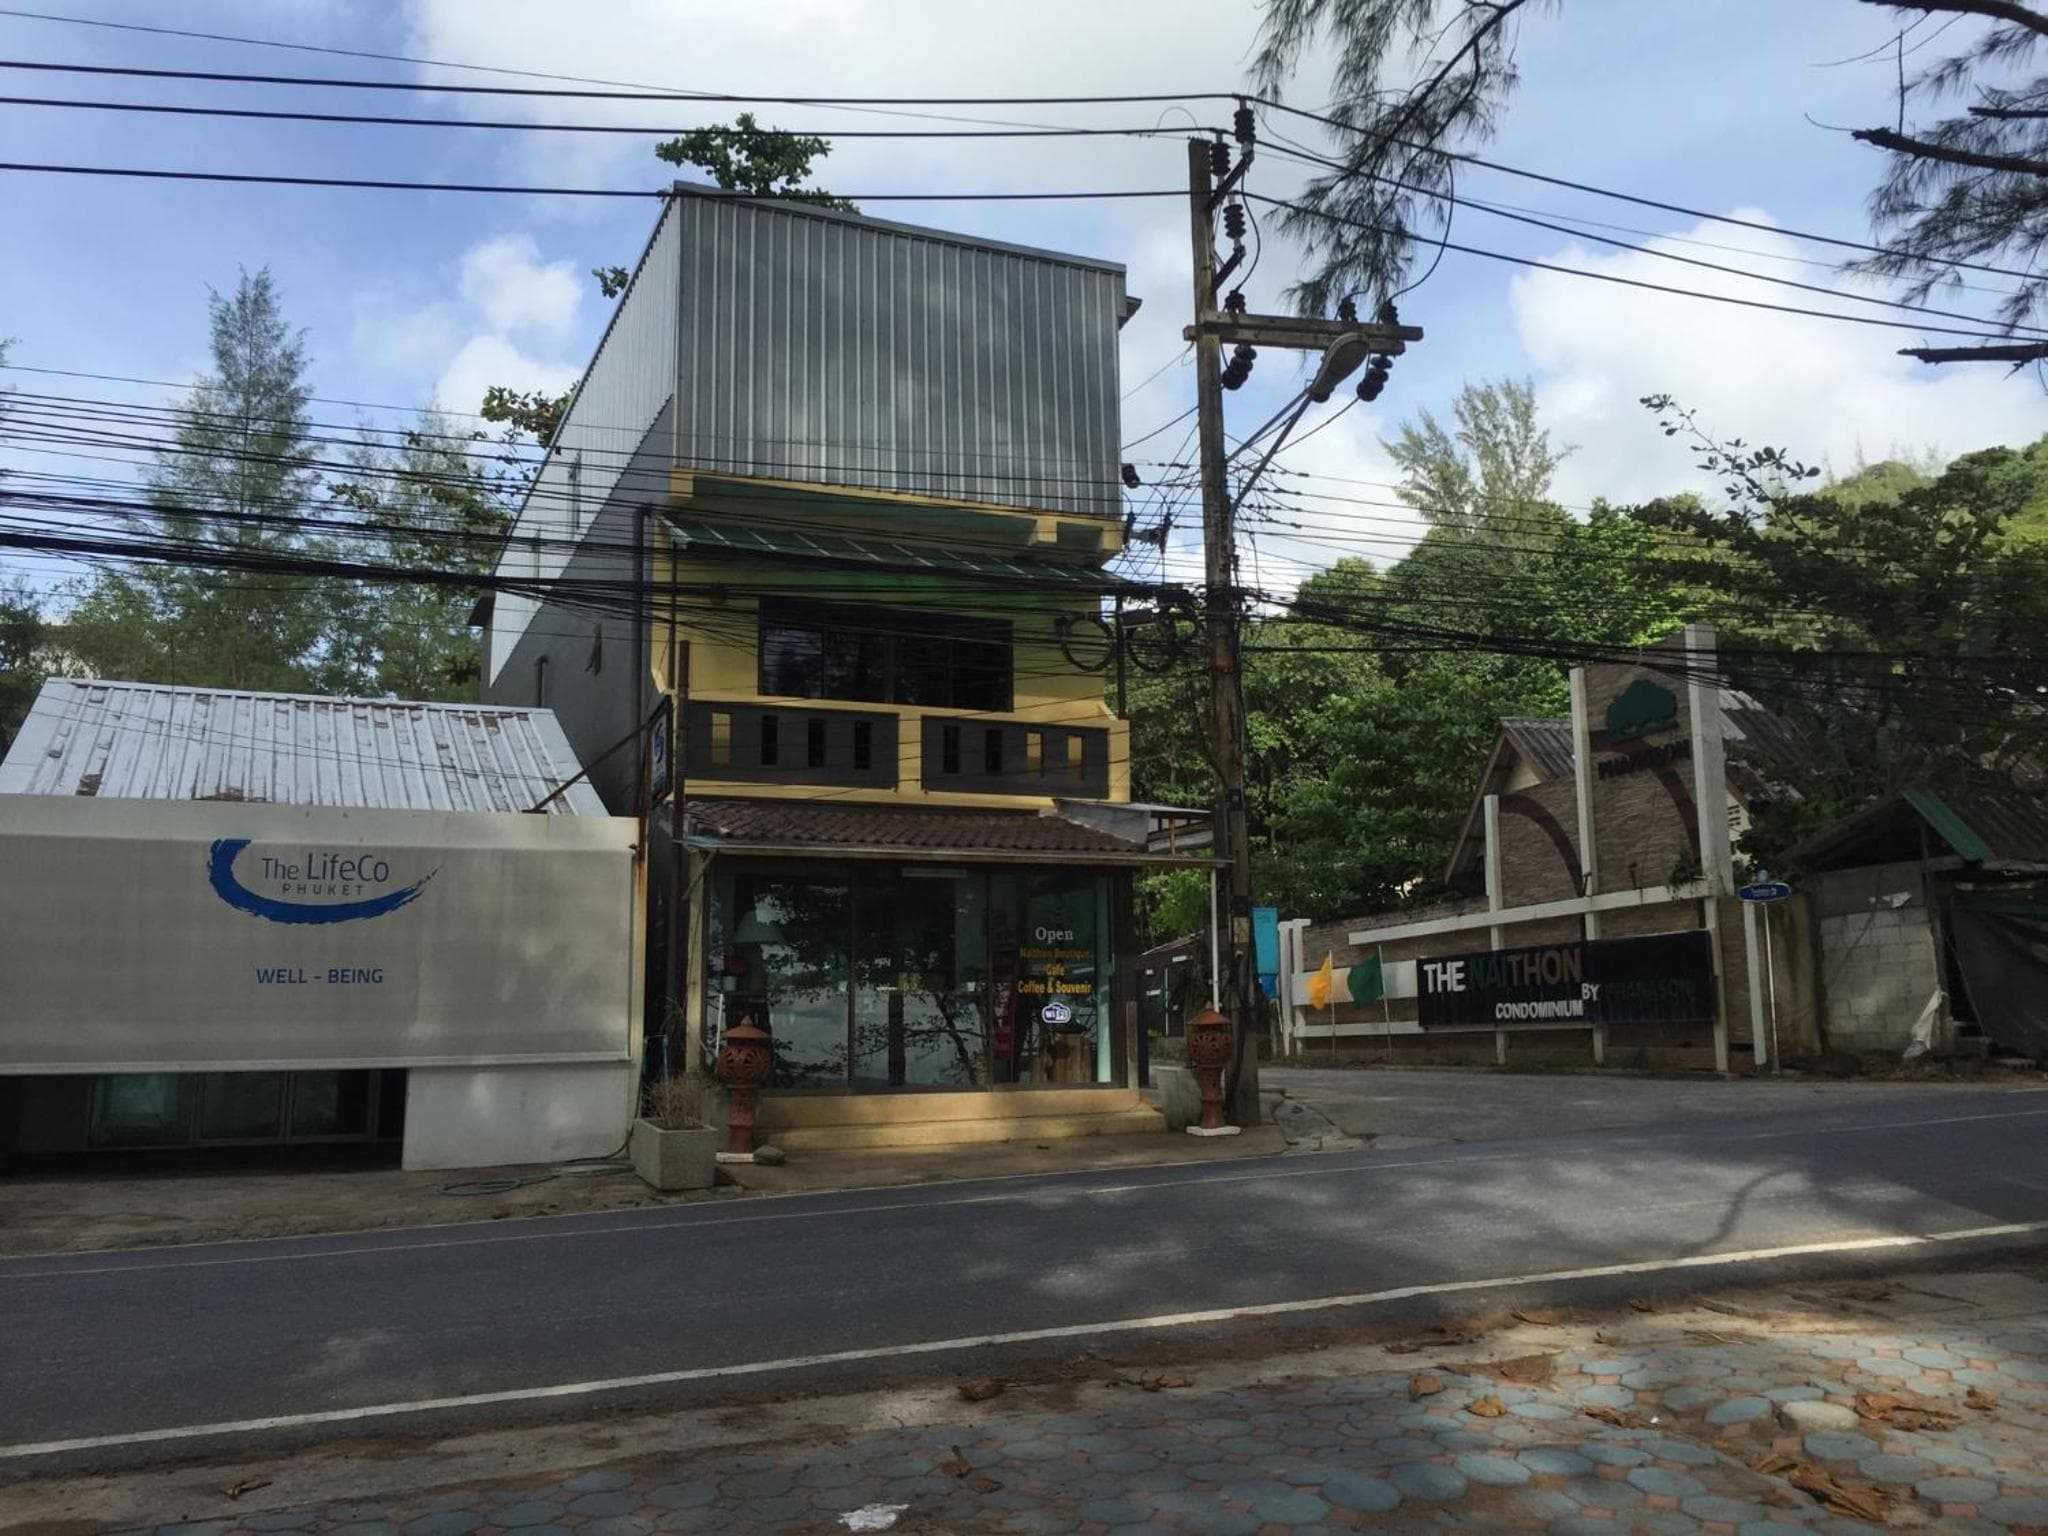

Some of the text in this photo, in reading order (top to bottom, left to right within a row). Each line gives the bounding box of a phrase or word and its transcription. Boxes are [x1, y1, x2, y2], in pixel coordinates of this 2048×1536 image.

[262, 852, 390, 883] The LifeCo
[282, 884, 363, 896] PHUKET
[1035, 926, 1074, 944] Open
[256, 968, 308, 984] WELL
[328, 968, 384, 984] BEING
[1422, 960, 1466, 995] THE
[1470, 948, 1584, 988] NAITHON
[1017, 980, 1092, 994] Coffee & Souvenir
[1581, 982, 1602, 1002] BY
[1495, 999, 1584, 1020] CONDOMINIUM
